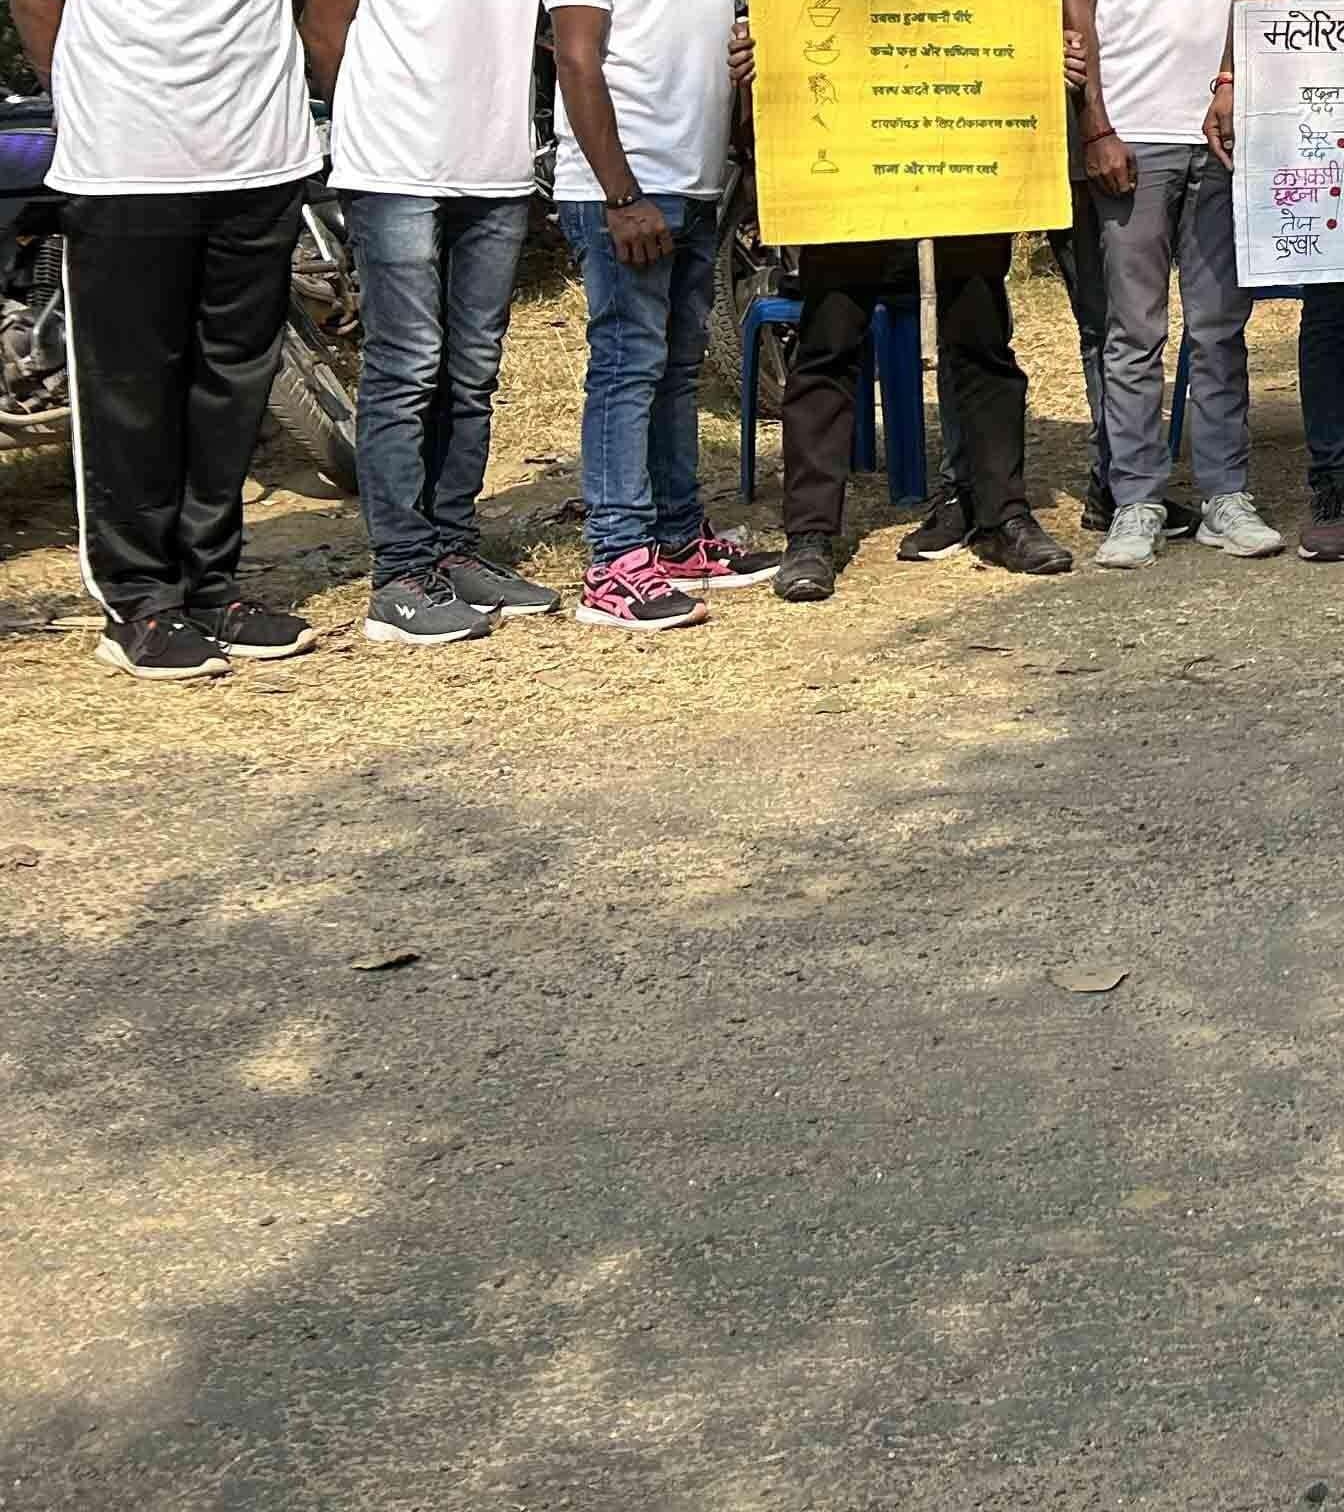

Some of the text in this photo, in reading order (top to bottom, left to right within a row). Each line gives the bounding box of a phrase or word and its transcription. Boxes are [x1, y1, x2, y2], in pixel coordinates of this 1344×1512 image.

[903, 12, 925, 26] हुआ
[927, 10, 950, 25] पानी
[920, 42, 942, 57] और
[922, 115, 934, 129] के
[956, 115, 1002, 129] टीकाकरण
[903, 161, 925, 175] और
[1272, 234, 1324, 260] बुखार
